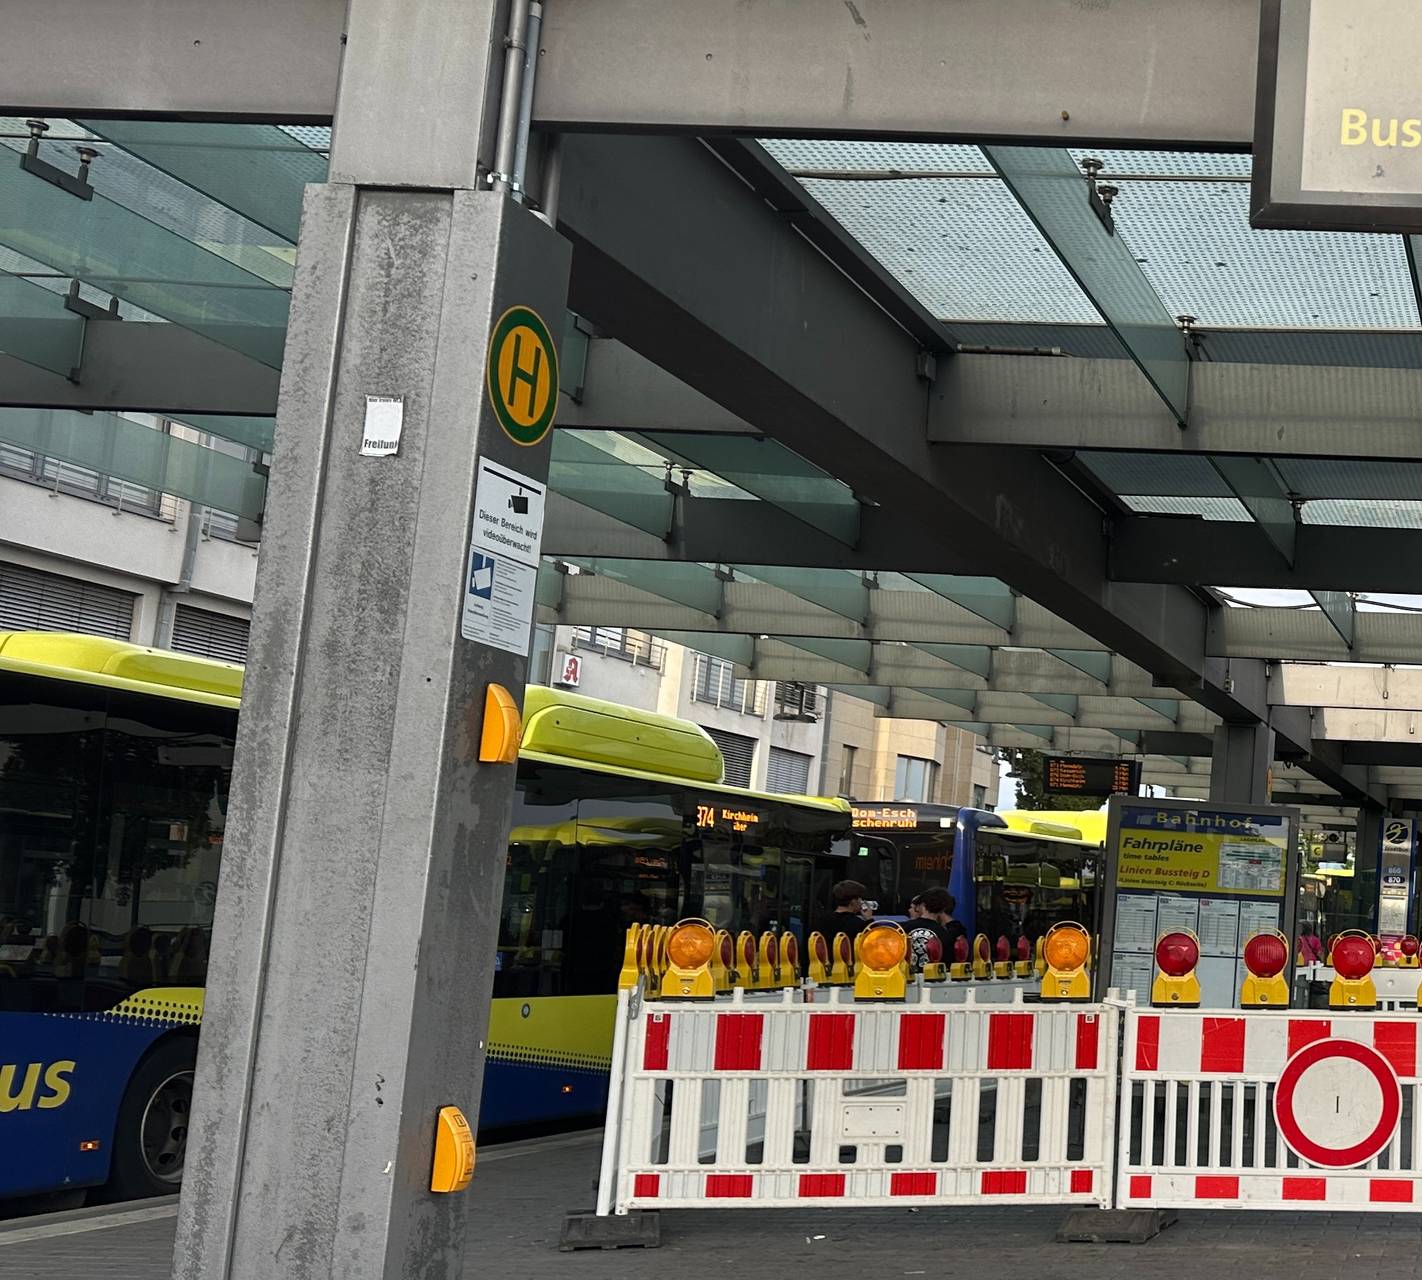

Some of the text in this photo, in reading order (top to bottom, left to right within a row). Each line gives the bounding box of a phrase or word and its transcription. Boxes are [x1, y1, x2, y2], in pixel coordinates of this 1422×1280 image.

[507, 333, 542, 419] H
[479, 509, 538, 540] Dieser Bereich wird
[483, 529, 532, 554] videoüberwacht!
[722, 809, 759, 823] Kirchheim
[1156, 812, 1252, 829] Bahnhof
[1123, 837, 1204, 854] Fahrpläne
[1123, 852, 1169, 862] time tables
[1120, 865, 1210, 879] Linien Bussteig D
[1388, 876, 1401, 884] 870
